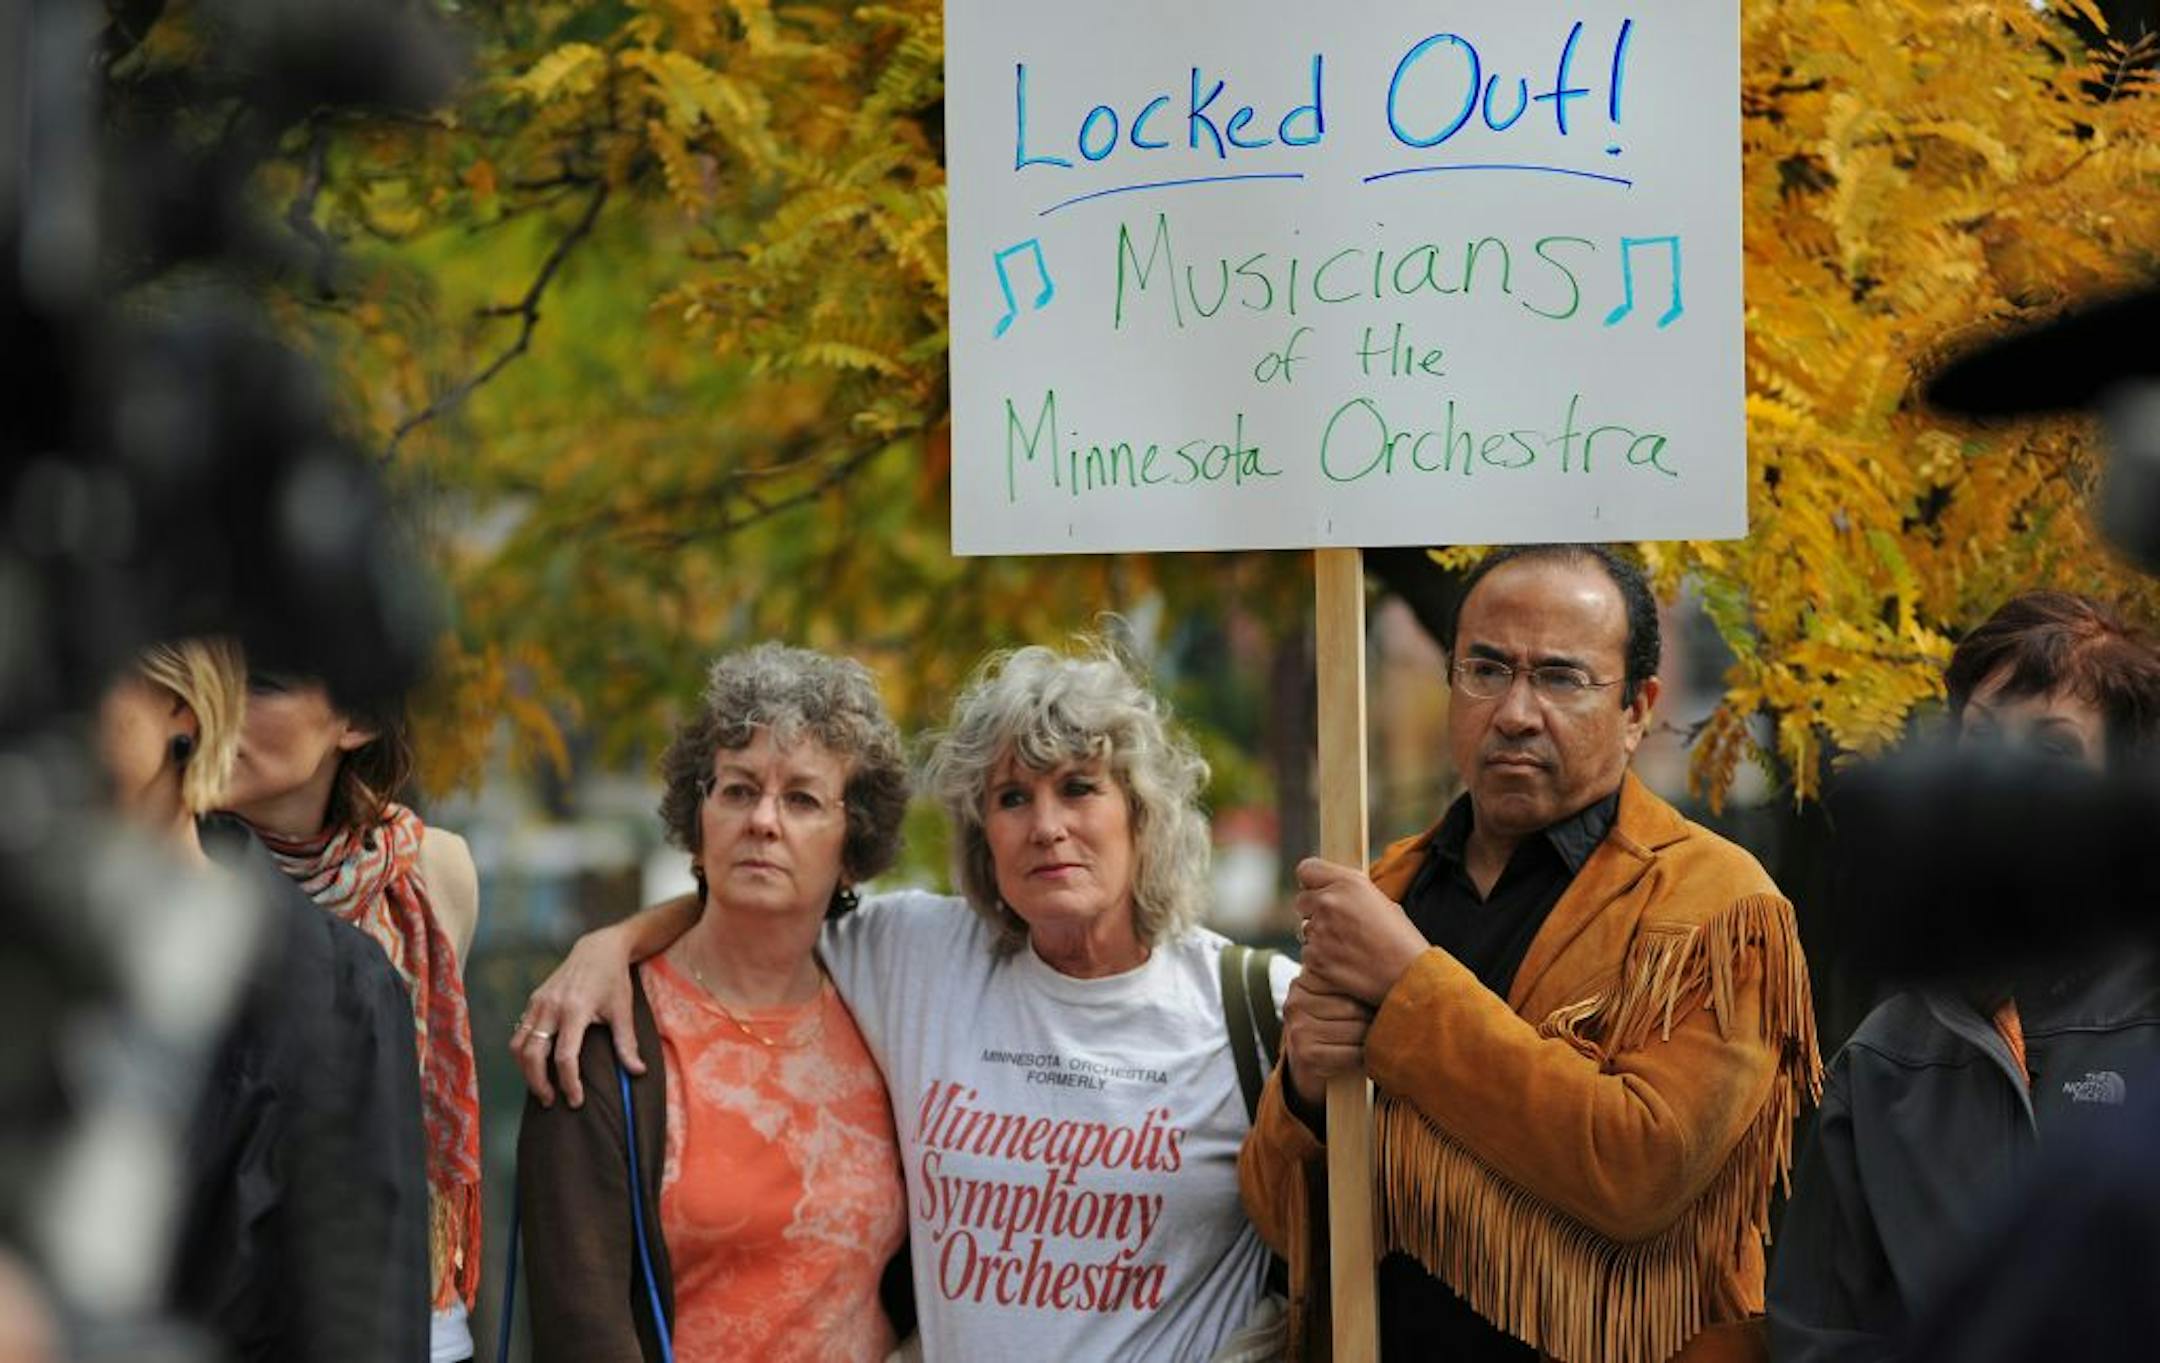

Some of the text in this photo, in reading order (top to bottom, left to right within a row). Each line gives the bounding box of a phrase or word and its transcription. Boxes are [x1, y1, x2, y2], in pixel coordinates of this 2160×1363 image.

[1015, 19, 1634, 172] Locked Out!
[1114, 213, 1597, 330] Musicians
[1254, 323, 1446, 385] of the
[1005, 389, 1679, 503] Minnesota Orchestra
[981, 1049, 1168, 1084] MINNESOTA ORCHESTRA
[1027, 1071, 1106, 1091] FORMERLY
[912, 1079, 1186, 1185] Minneapolis
[919, 1151, 1164, 1260] Symphony
[939, 1230, 1167, 1313] Orchestra
